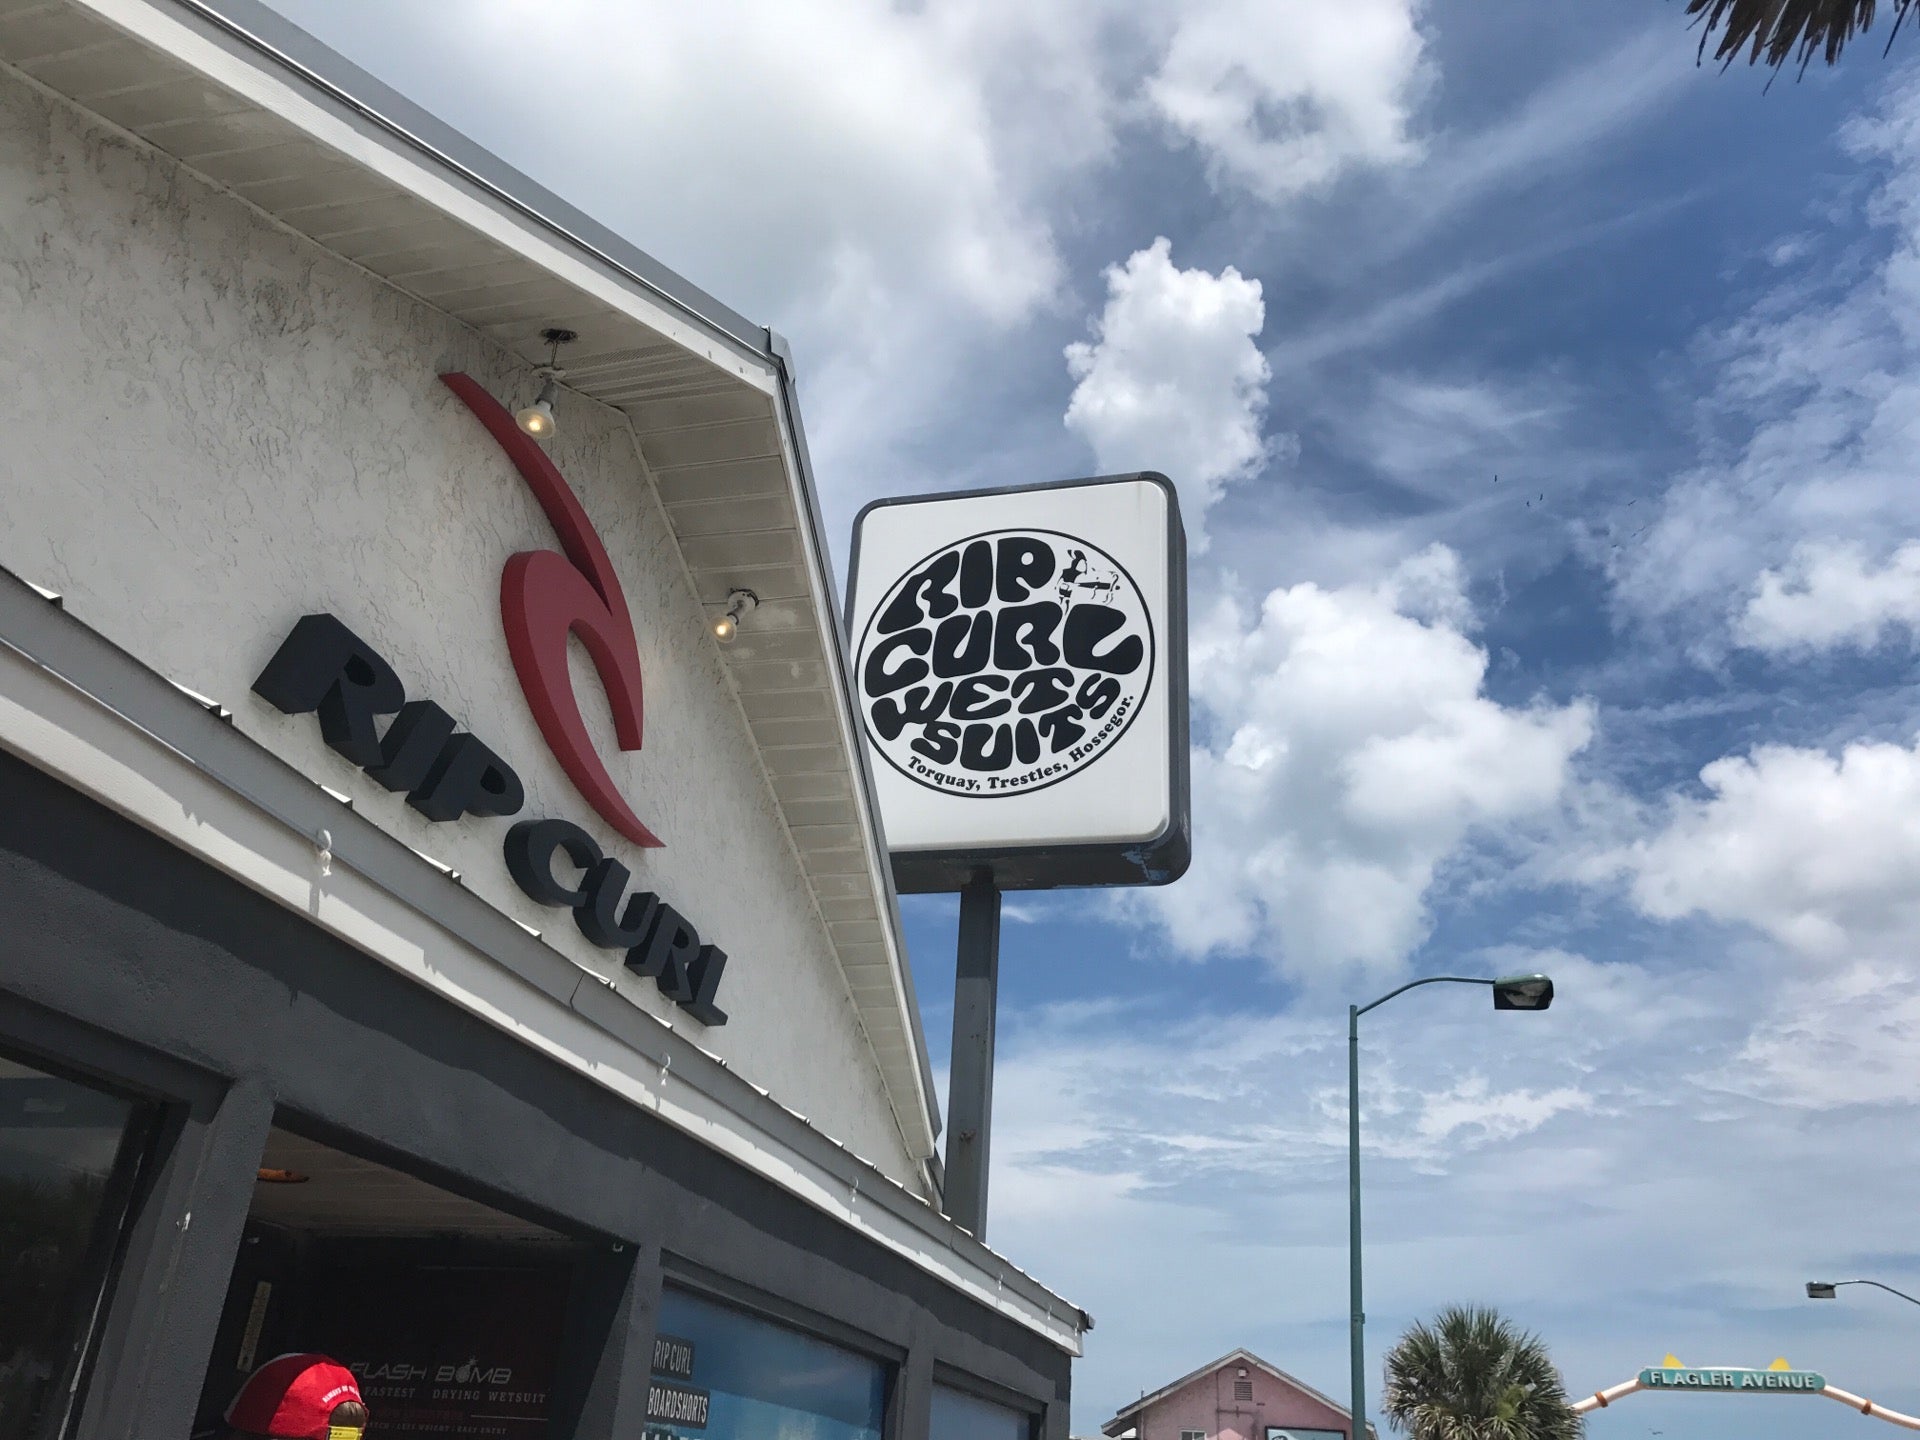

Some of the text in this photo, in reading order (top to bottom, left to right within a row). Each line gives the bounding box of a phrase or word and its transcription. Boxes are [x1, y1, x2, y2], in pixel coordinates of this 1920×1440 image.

[877, 537, 1056, 634] RIP
[864, 600, 1144, 698] CURL
[907, 694, 1134, 791] Torquay, Trestles, Hossegor.
[251, 613, 729, 1027] RIP CURL
[350, 1362, 427, 1380] FLASH
[653, 1340, 692, 1375] RIP CURL
[364, 1386, 416, 1398] FASTEST
[432, 1388, 480, 1401] DRYING
[488, 1391, 546, 1403] WETSUIT
[1650, 1371, 1816, 1389] FLAGLER AVENUE
[647, 1386, 708, 1424] BOARDSHORTS
